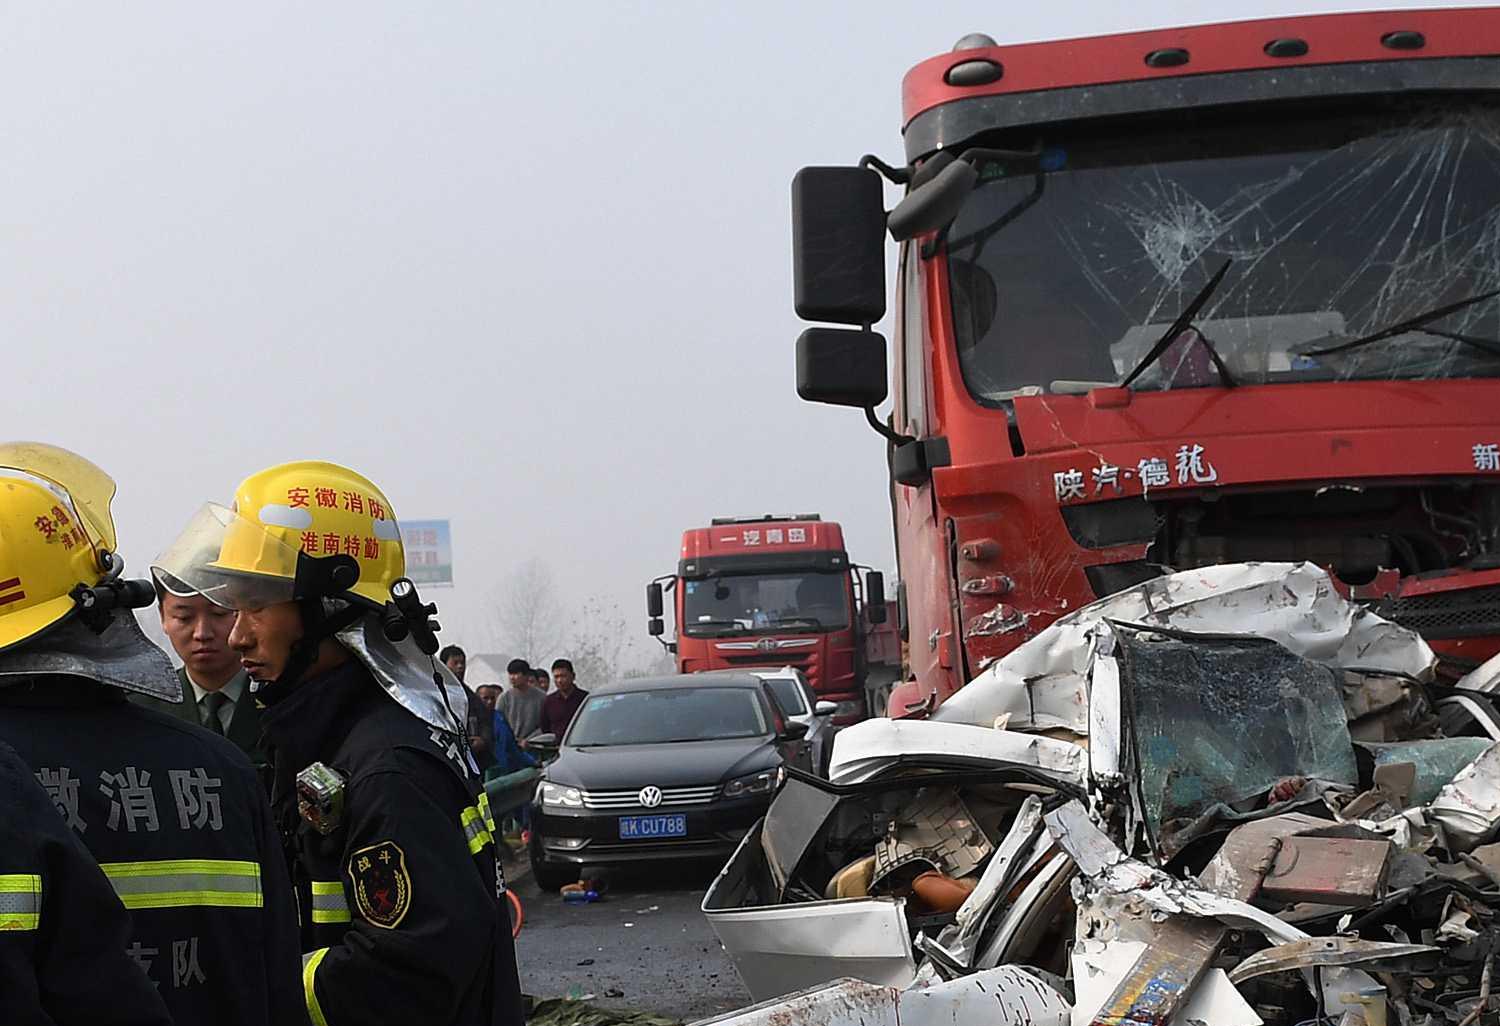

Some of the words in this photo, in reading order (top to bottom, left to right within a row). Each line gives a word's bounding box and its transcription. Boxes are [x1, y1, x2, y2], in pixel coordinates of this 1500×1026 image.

[288, 487, 385, 521] 安徽消防
[300, 531, 379, 559] 淮南特勤
